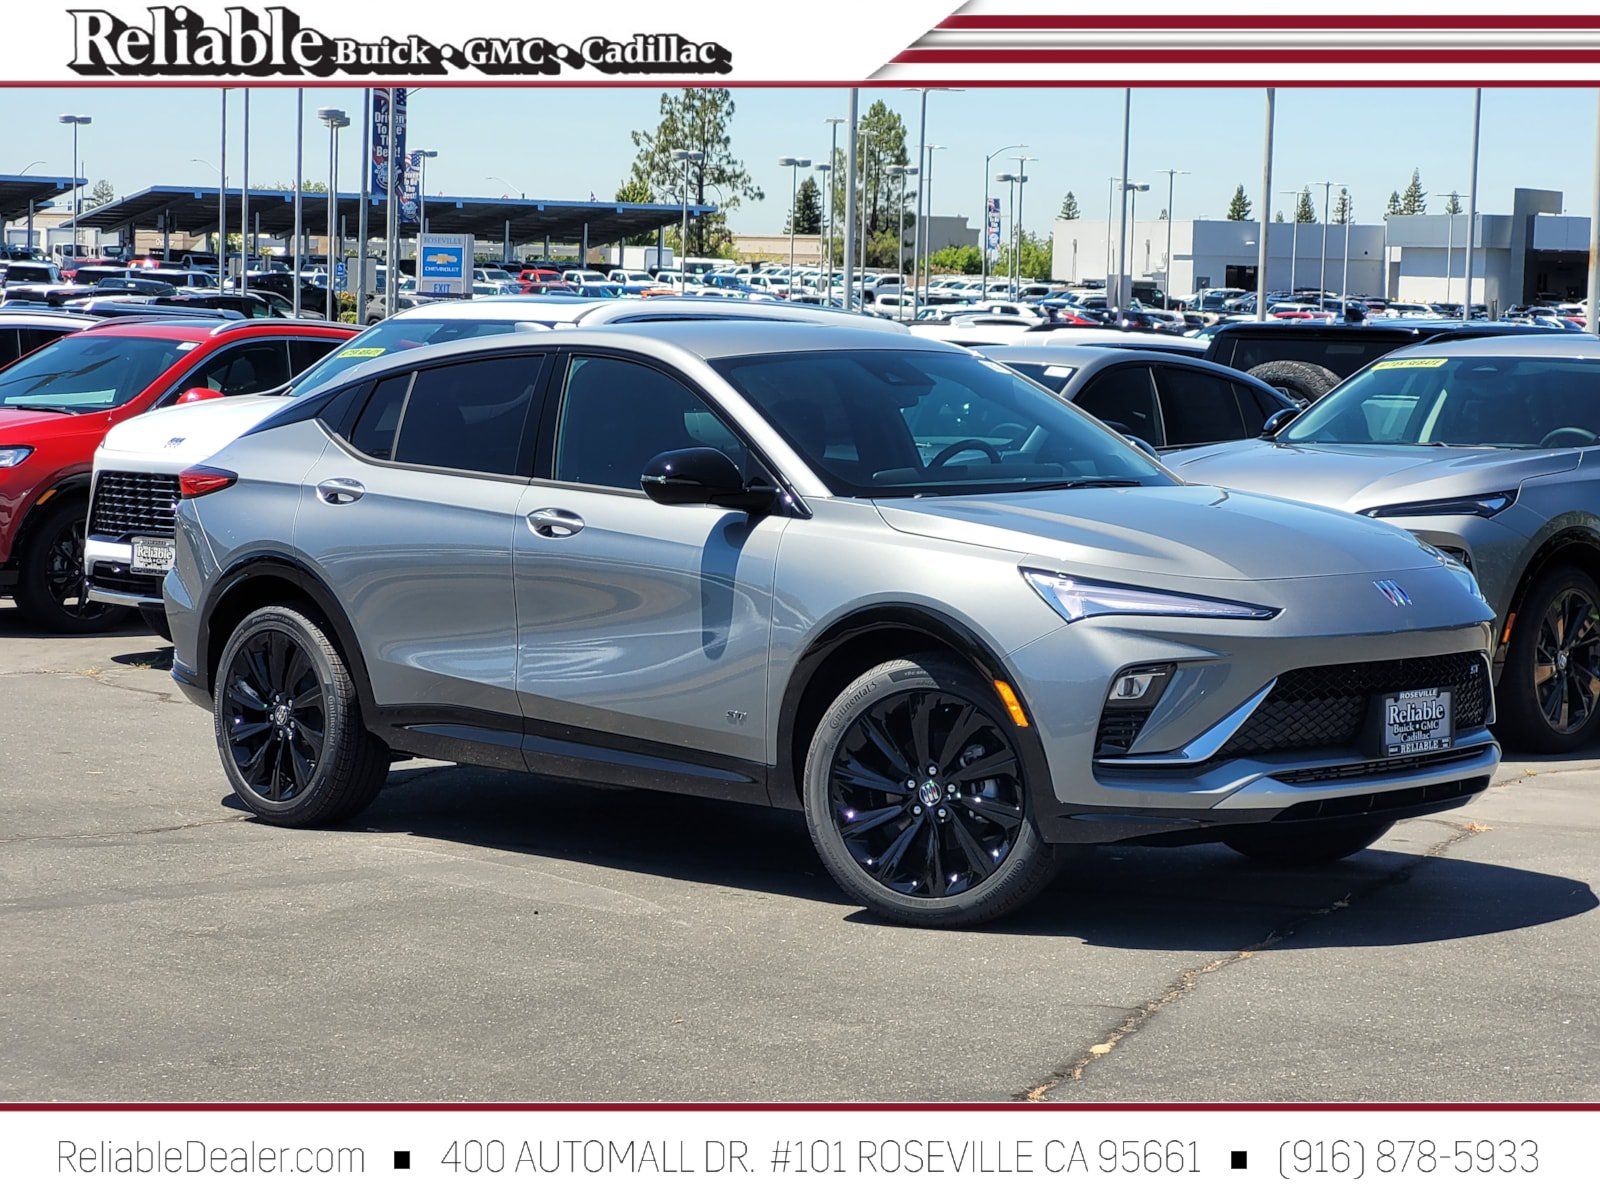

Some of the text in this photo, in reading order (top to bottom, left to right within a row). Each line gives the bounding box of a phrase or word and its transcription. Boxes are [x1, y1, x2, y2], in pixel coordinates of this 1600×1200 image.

[375, 112, 404, 124] Drien
[433, 283, 451, 293] EXIT
[138, 546, 172, 559] Reliable
[1400, 689, 1437, 700] ROSEVILLE
[1389, 700, 1444, 725] Reliable
[1393, 720, 1439, 734] Buick GMC
[1401, 731, 1430, 743] Cadillac
[1400, 741, 1439, 754] RELIABLE
